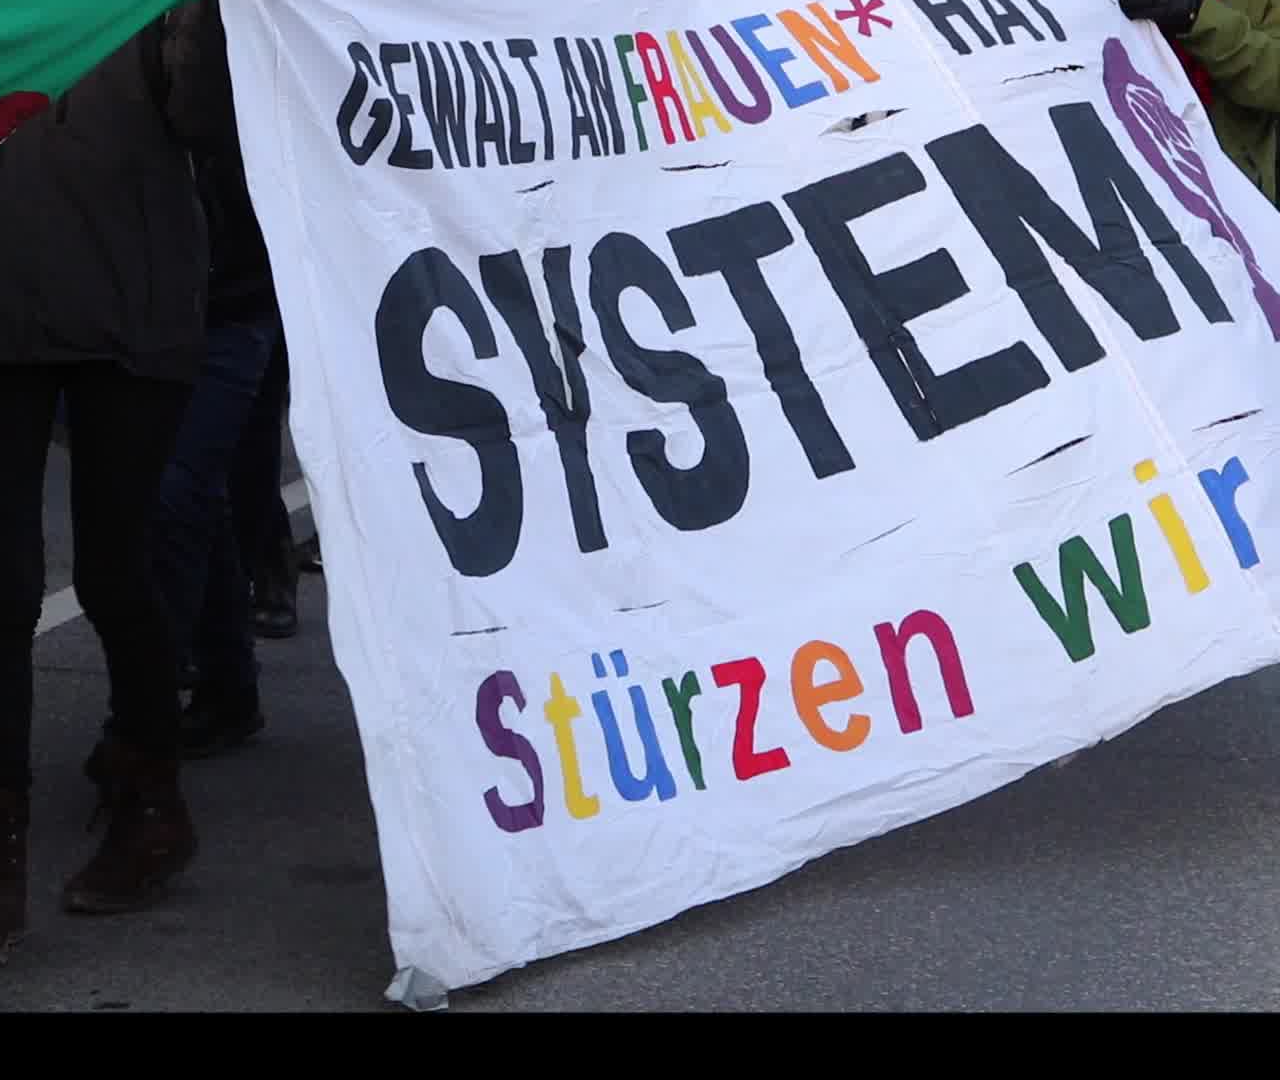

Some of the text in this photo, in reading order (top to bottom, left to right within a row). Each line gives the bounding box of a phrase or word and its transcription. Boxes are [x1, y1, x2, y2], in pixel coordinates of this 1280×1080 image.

[336, 36, 555, 170] GEWALT
[555, 36, 626, 161] AN
[373, 100, 1236, 579] SYSTEM
[1010, 456, 1259, 664] wir
